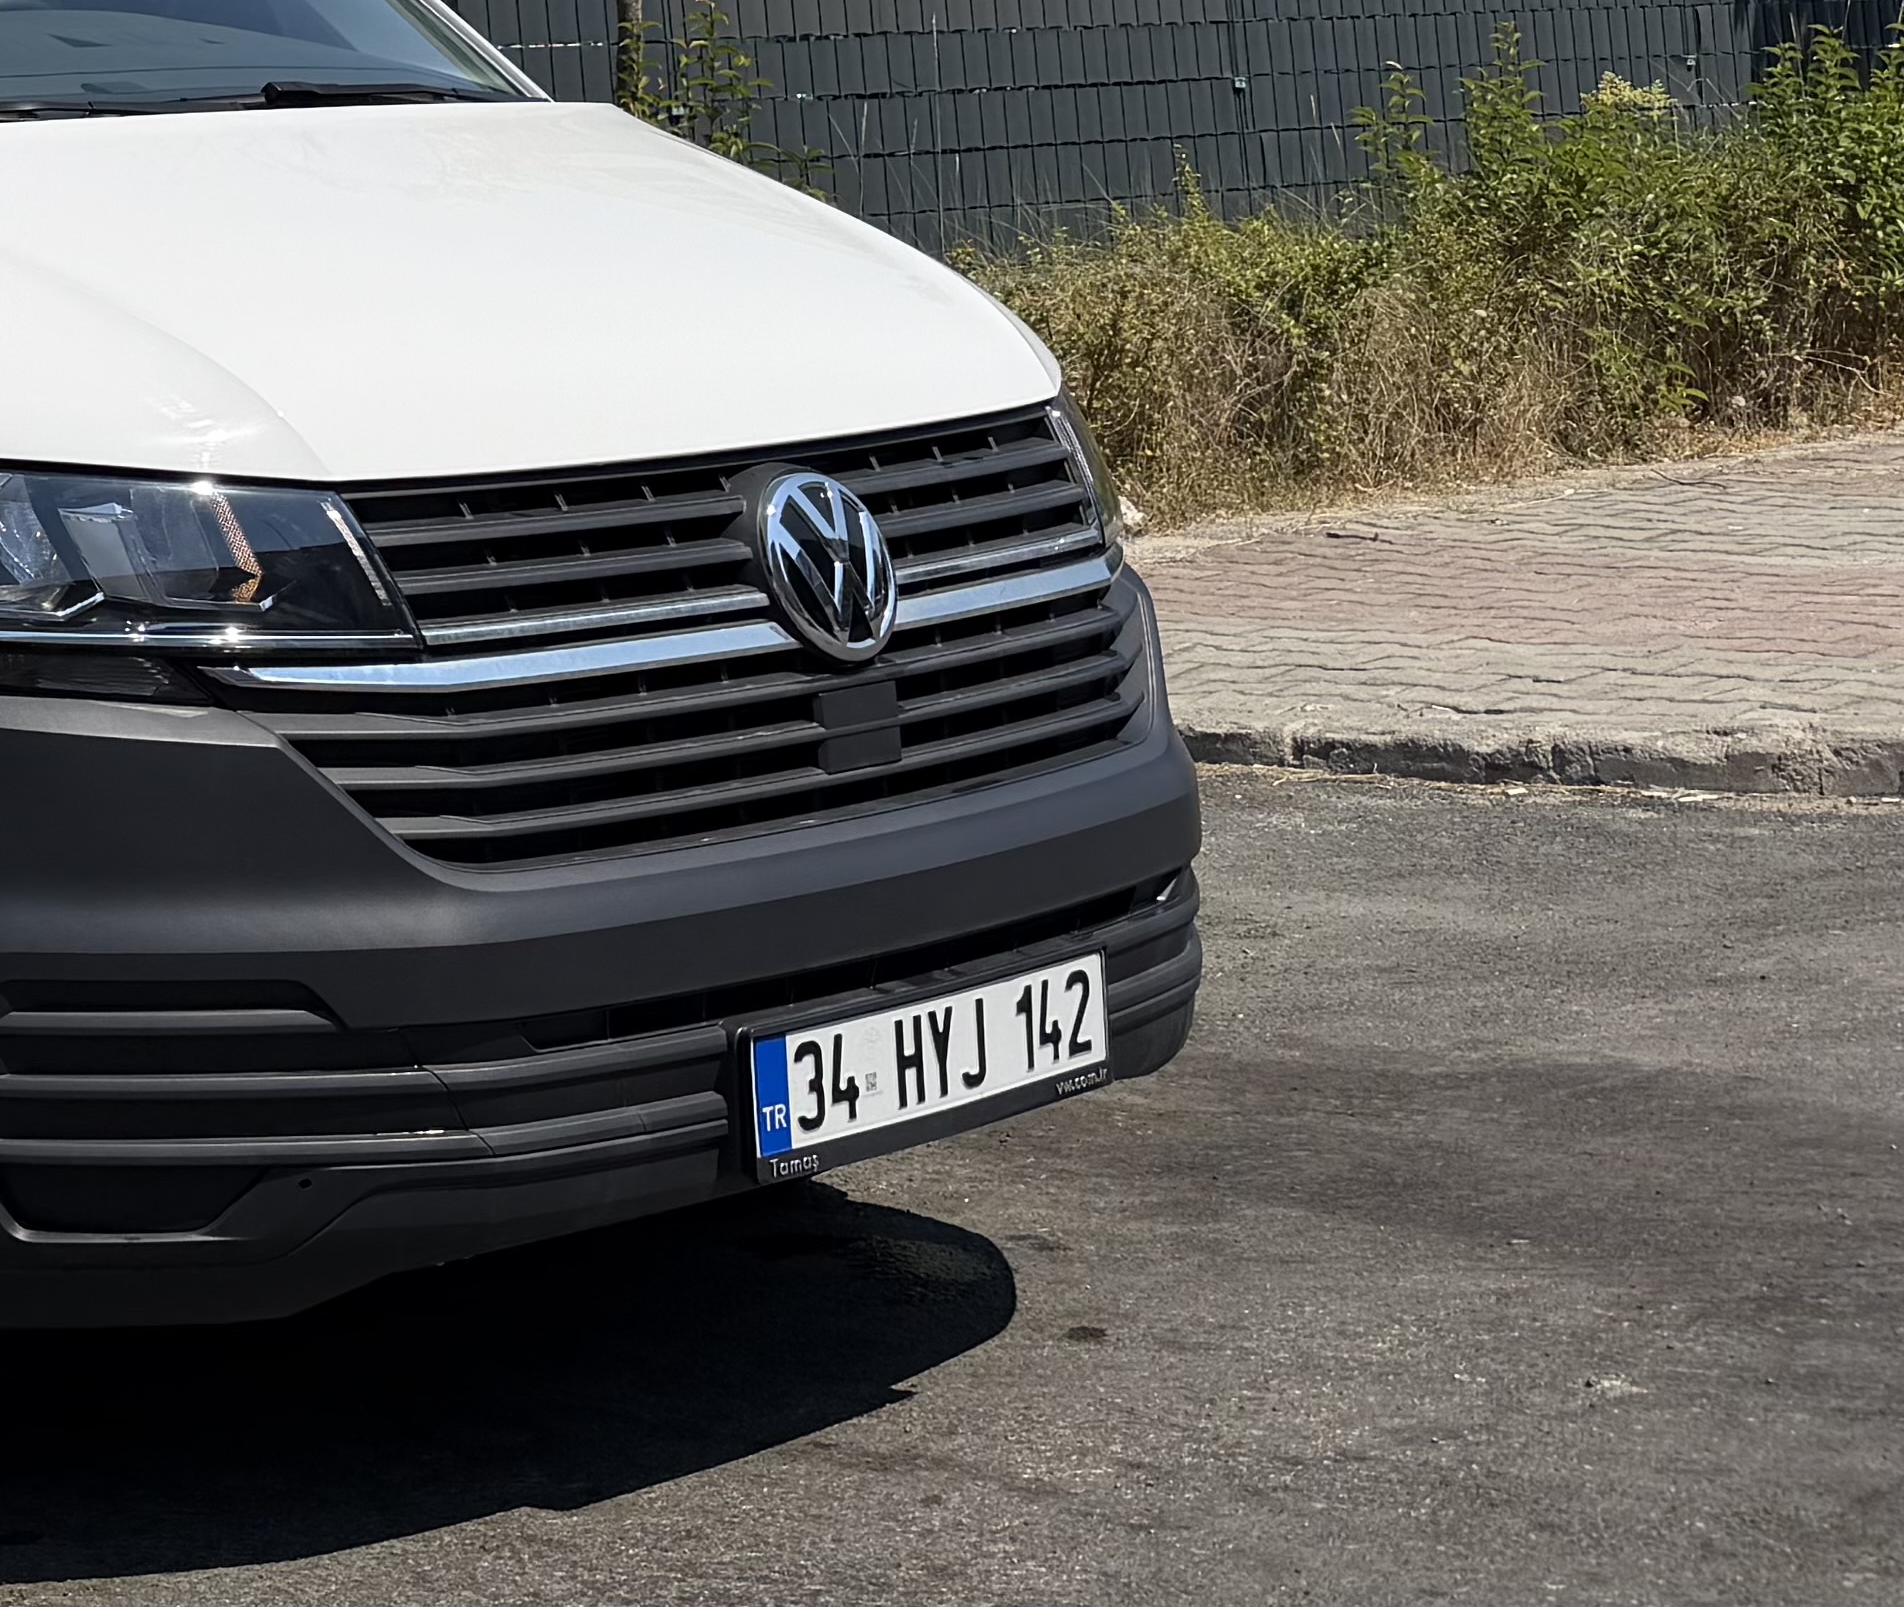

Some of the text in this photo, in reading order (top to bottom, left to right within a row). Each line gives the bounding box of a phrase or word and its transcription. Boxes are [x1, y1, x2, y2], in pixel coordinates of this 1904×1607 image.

[762, 969, 1093, 1132] TR 34 HYJ 142
[768, 1152, 820, 1179] Tamaş
